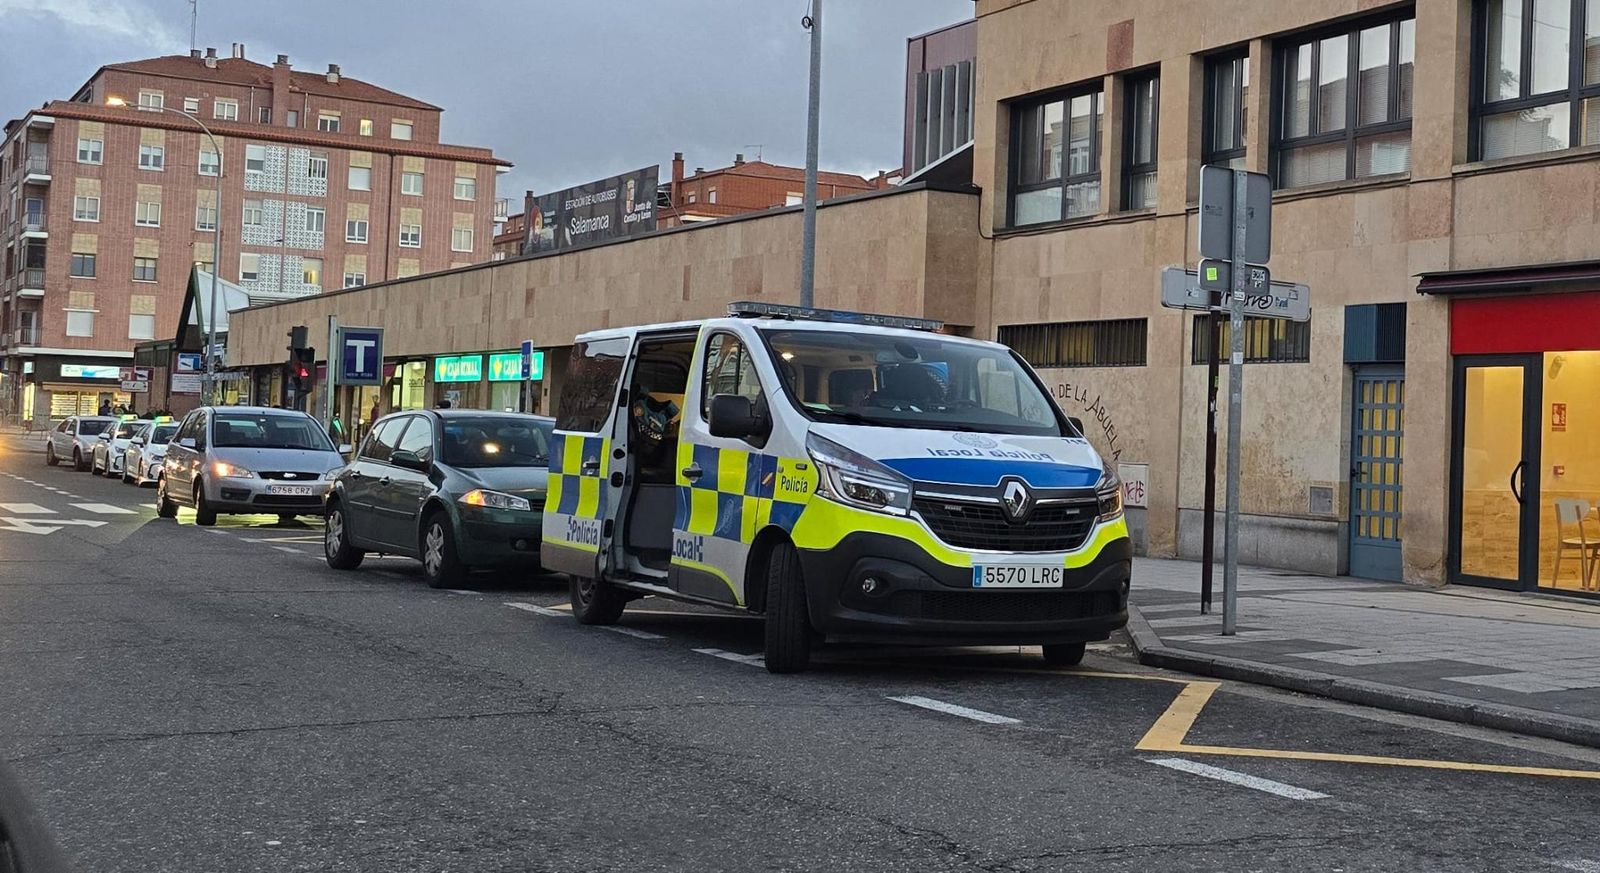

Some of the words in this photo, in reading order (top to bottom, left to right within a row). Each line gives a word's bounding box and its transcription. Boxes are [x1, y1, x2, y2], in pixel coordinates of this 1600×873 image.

[570, 215, 609, 235] Salamanca
[346, 339, 376, 372] T
[1059, 384, 1072, 398] DE
[1075, 385, 1087, 404] LA
[1085, 395, 1122, 461] ABUELA
[295, 487, 311, 495] CRZ
[781, 475, 808, 493] Policía
[571, 520, 598, 545] Policía
[986, 567, 1027, 584] 5570
[1031, 567, 1060, 584] LRC
